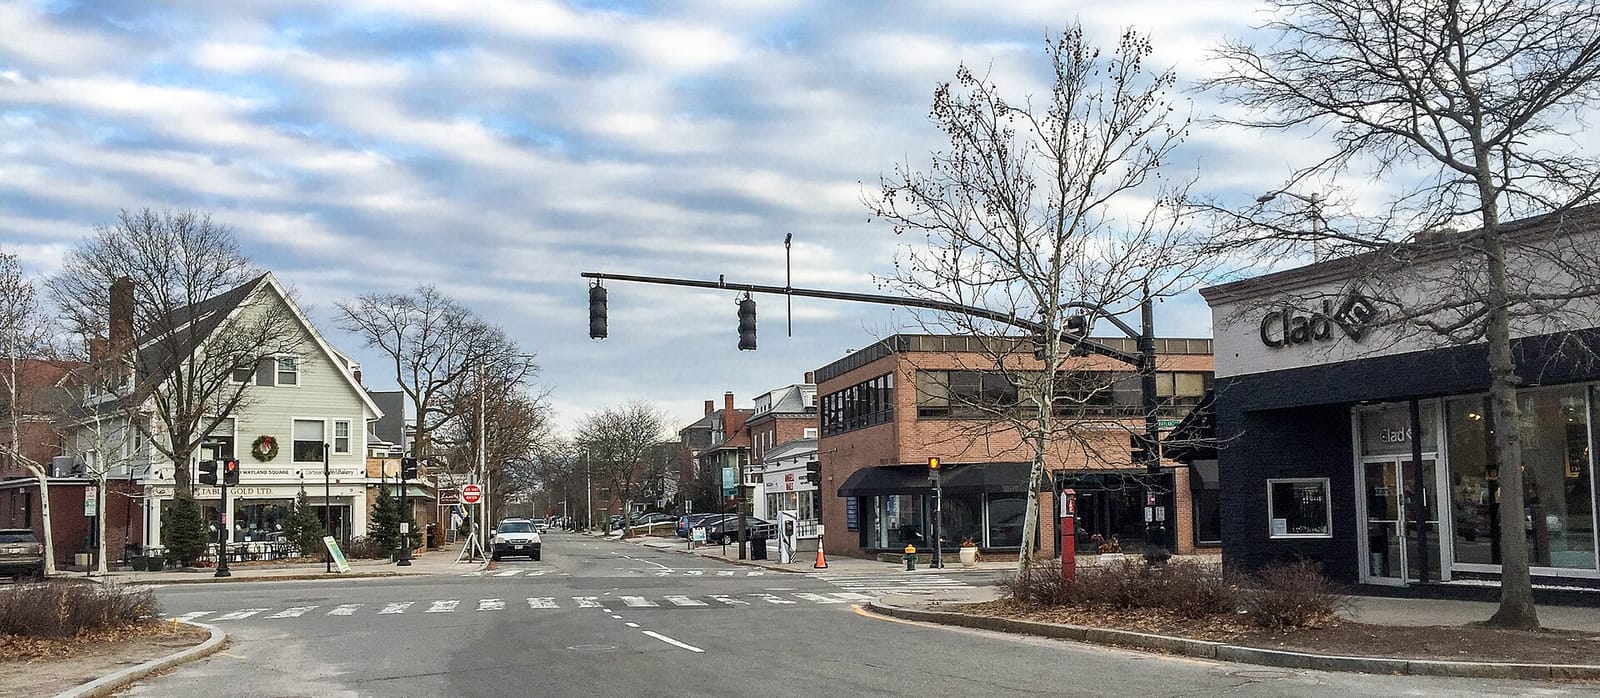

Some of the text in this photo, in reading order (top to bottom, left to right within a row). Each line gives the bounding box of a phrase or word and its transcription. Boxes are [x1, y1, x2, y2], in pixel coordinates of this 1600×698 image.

[1260, 300, 1333, 348] Clad
[1379, 426, 1405, 443] Clad
[256, 487, 273, 495] LTD
